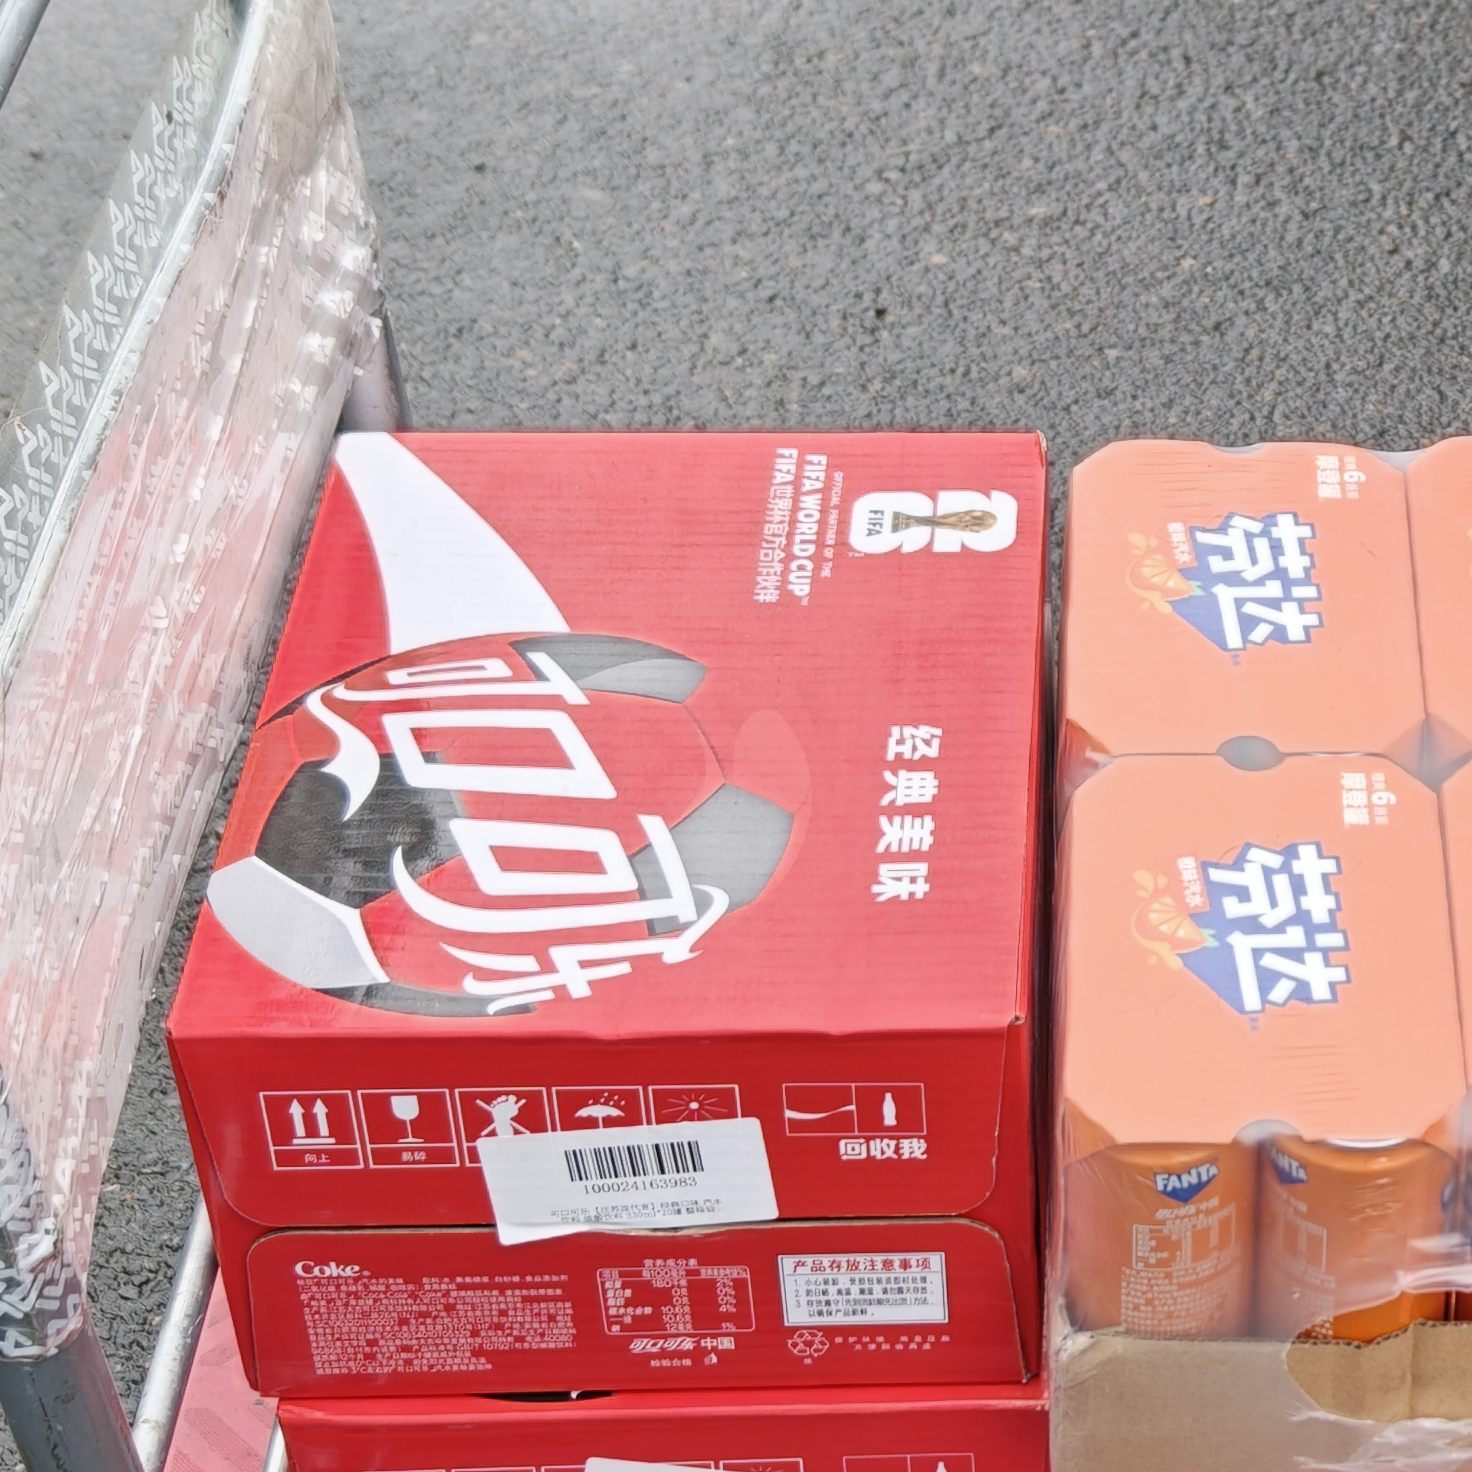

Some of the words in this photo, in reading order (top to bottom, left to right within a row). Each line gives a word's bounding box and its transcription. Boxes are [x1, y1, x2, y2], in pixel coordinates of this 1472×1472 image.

[801, 453, 828, 492] FIFA
[792, 492, 823, 558] WORLD
[865, 508, 885, 537] FIFA
[820, 561, 833, 579] THE
[1194, 513, 1320, 649] 芬达
[870, 723, 943, 903] 经典美味
[1207, 844, 1347, 1012] 芬达
[837, 1137, 929, 1162] 回收我
[584, 1176, 699, 1196] 100024163983
[1154, 1162, 1219, 1193] FANTA
[294, 1260, 362, 1278] Coke
[792, 1257, 933, 1274] 产品存放注意事项
[700, 1336, 736, 1350] 中国
